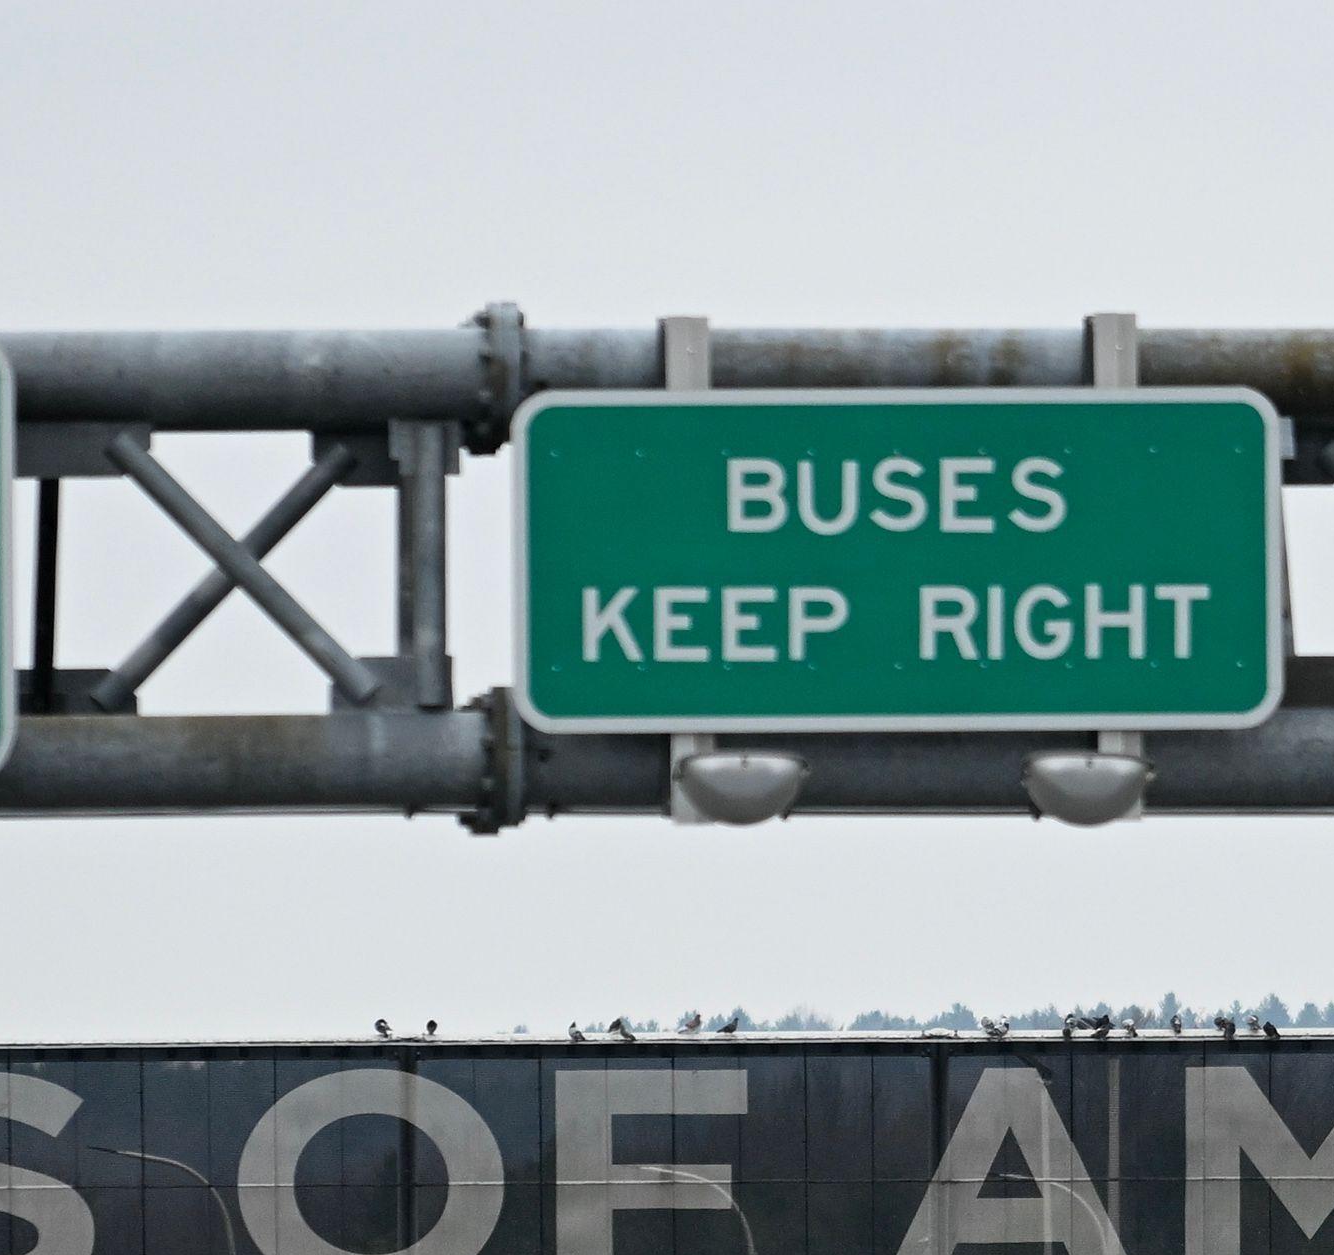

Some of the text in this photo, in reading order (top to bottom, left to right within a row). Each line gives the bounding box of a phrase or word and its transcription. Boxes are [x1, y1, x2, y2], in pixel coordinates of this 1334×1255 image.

[726, 457, 1066, 535] BUSES
[582, 584, 1211, 662] KEEP RIGHT
